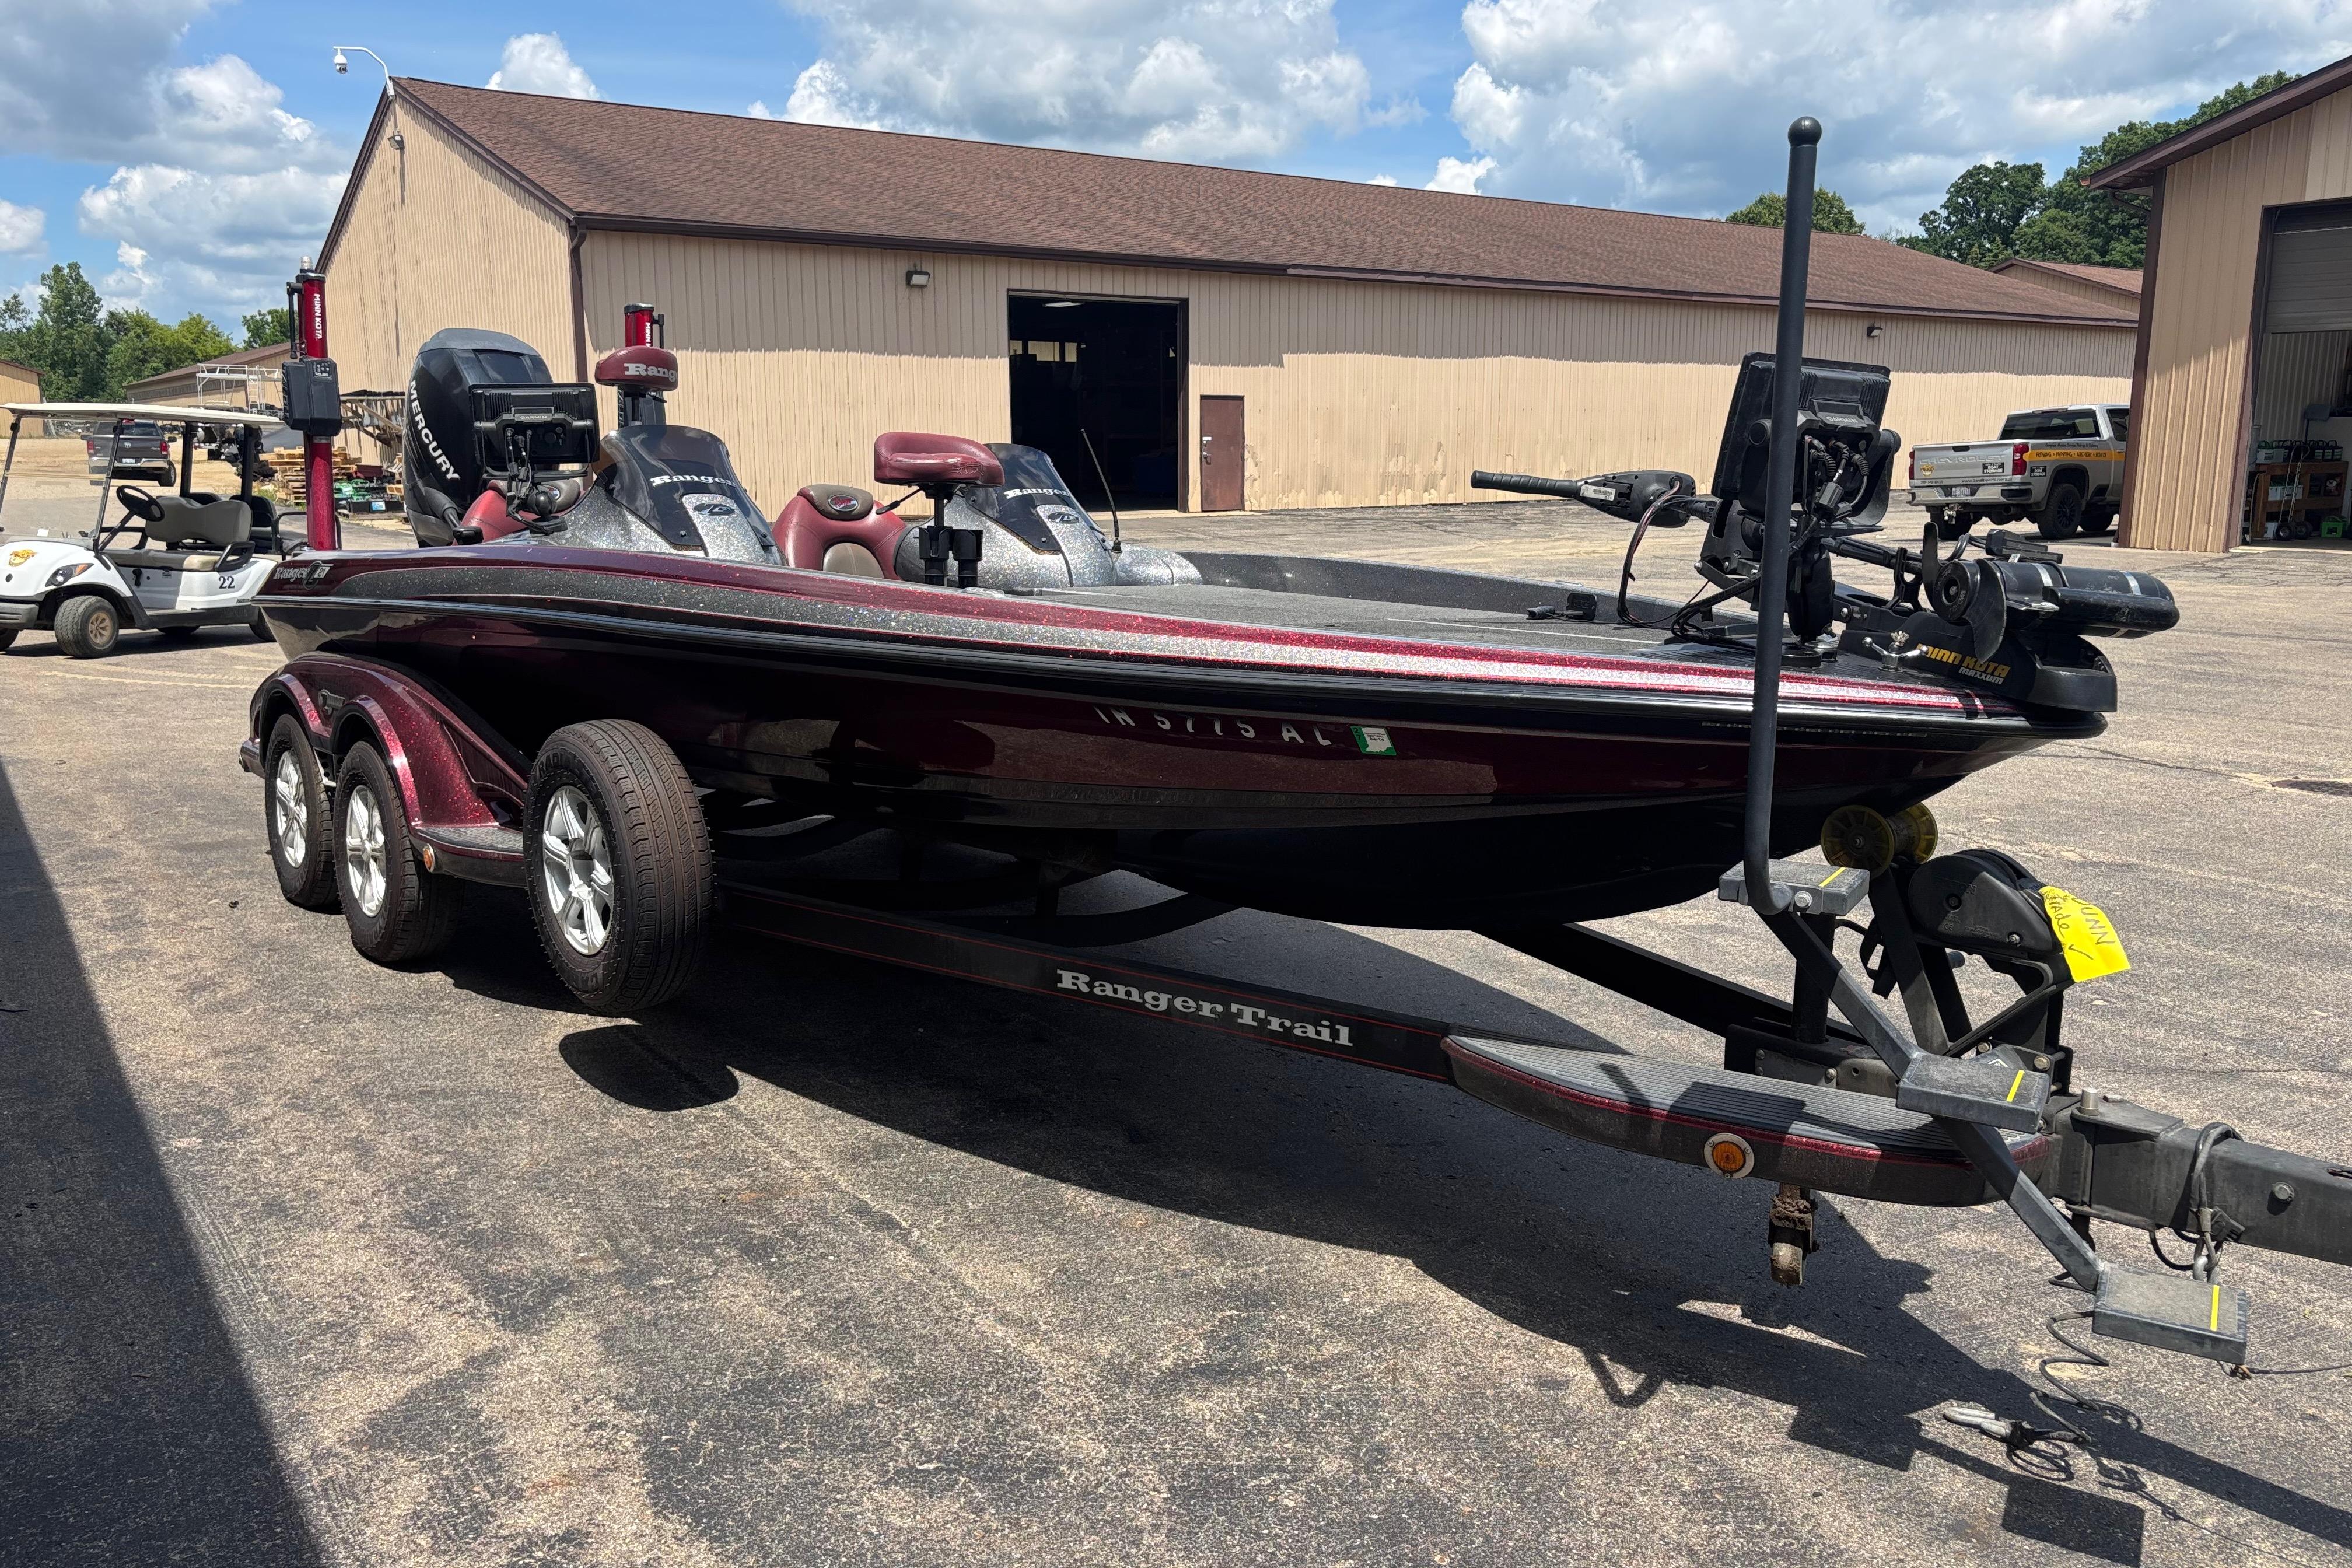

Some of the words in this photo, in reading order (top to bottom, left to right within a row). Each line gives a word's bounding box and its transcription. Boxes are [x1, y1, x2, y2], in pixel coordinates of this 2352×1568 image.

[410, 379, 461, 481] MERCURY
[1919, 455, 2006, 465] CHEVROLET
[649, 475, 736, 488] Ranger
[1003, 488, 1071, 499] Ranger
[272, 566, 311, 582] Ranger
[218, 576, 235, 589] 22
[1962, 656, 2011, 678] KOTA
[1093, 706, 1136, 726] IN
[1152, 711, 1255, 738] 5775
[1281, 721, 1332, 746] AL
[1056, 969, 1224, 1019] Ranger
[1230, 1003, 1353, 1047] Trail
